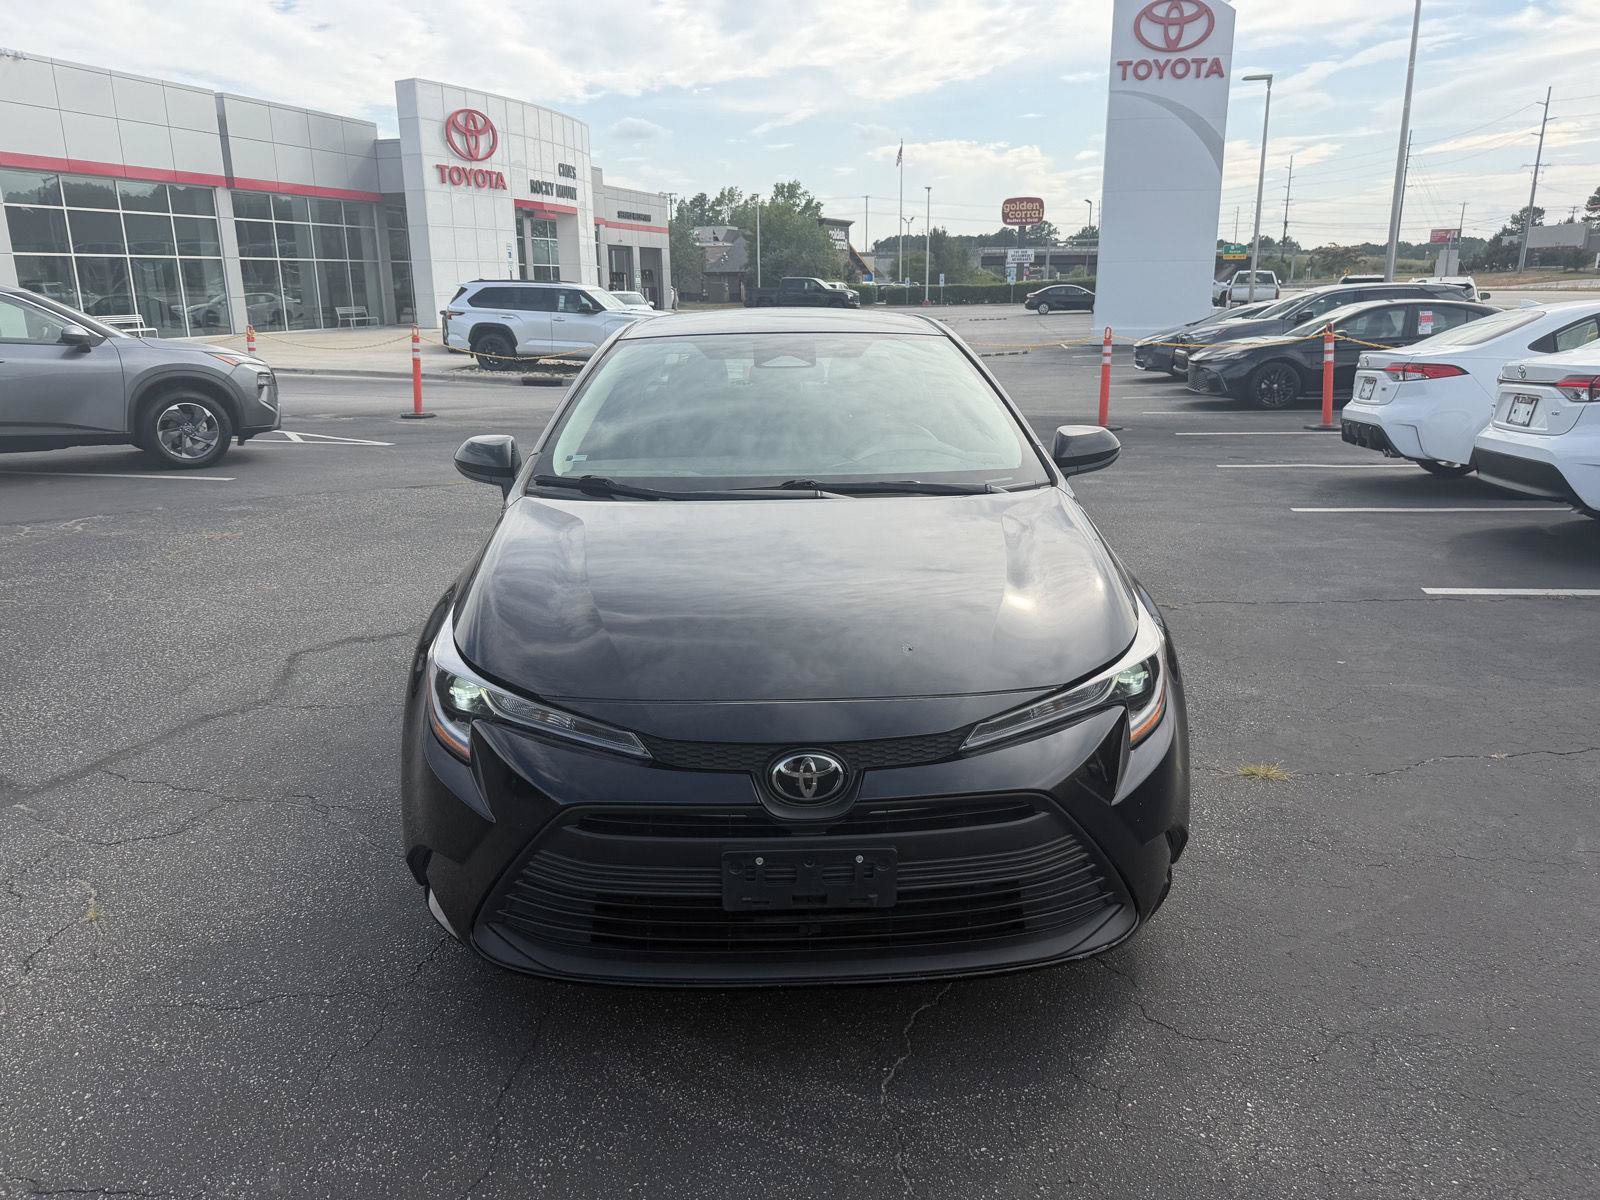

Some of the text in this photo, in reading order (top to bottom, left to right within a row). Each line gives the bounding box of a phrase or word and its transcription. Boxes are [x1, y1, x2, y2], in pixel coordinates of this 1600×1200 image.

[1117, 57, 1225, 81] TOYOTA
[436, 164, 507, 190] TOYOTA
[530, 179, 554, 197] ROCKY
[1003, 201, 1040, 212] golden
[1009, 210, 1043, 219] corral
